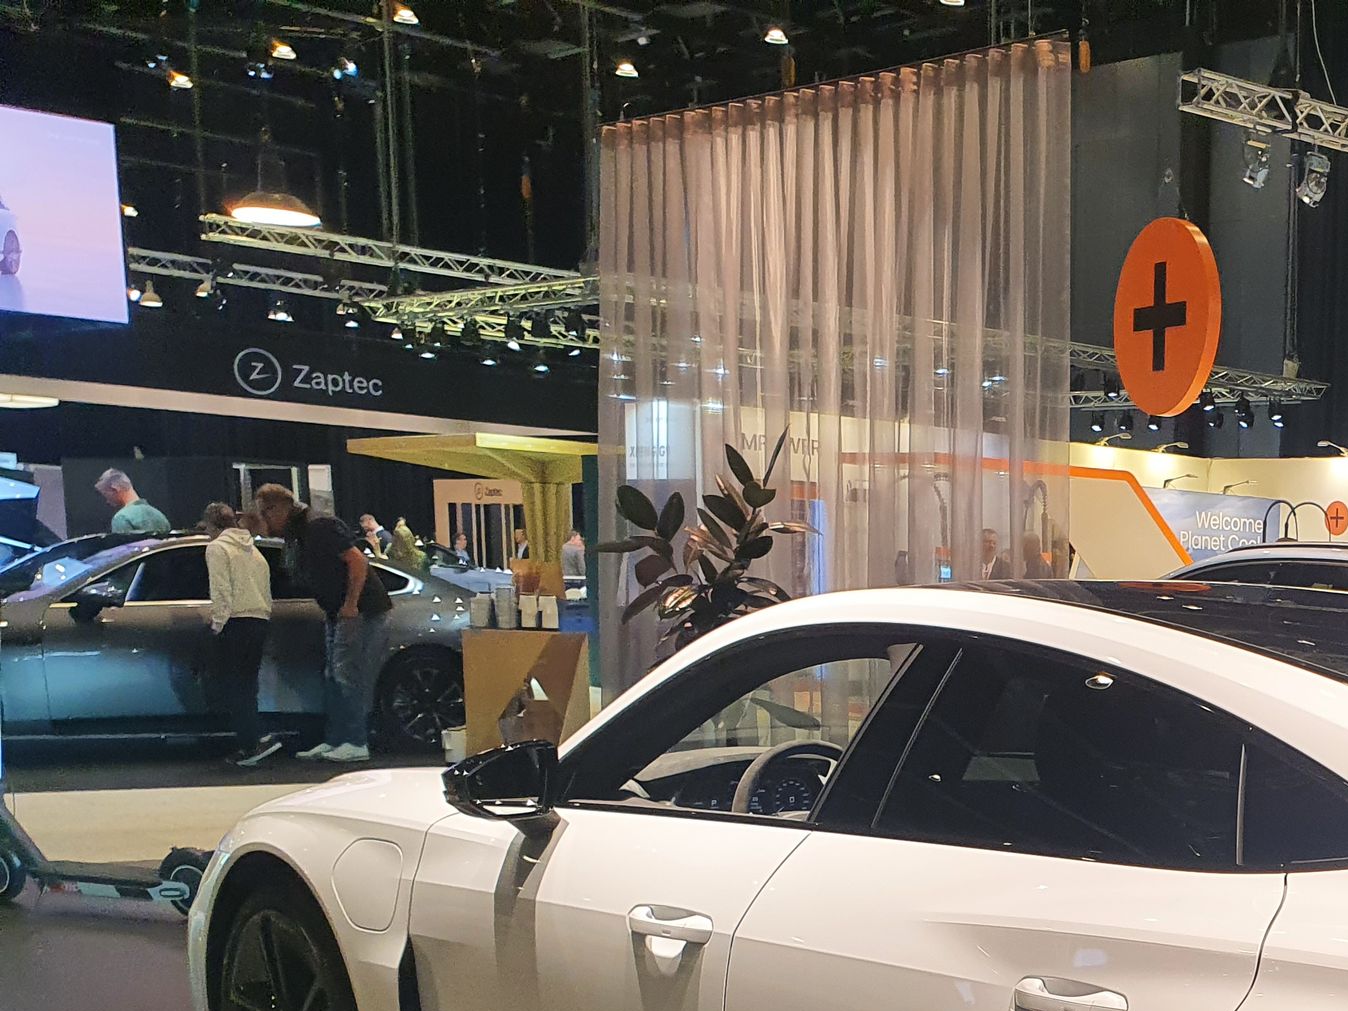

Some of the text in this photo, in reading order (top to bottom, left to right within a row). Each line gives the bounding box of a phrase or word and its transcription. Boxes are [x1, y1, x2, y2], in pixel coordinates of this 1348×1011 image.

[292, 364, 383, 396] Zaptec
[1195, 510, 1264, 533] Welcome
[1180, 530, 1226, 551] Planet
